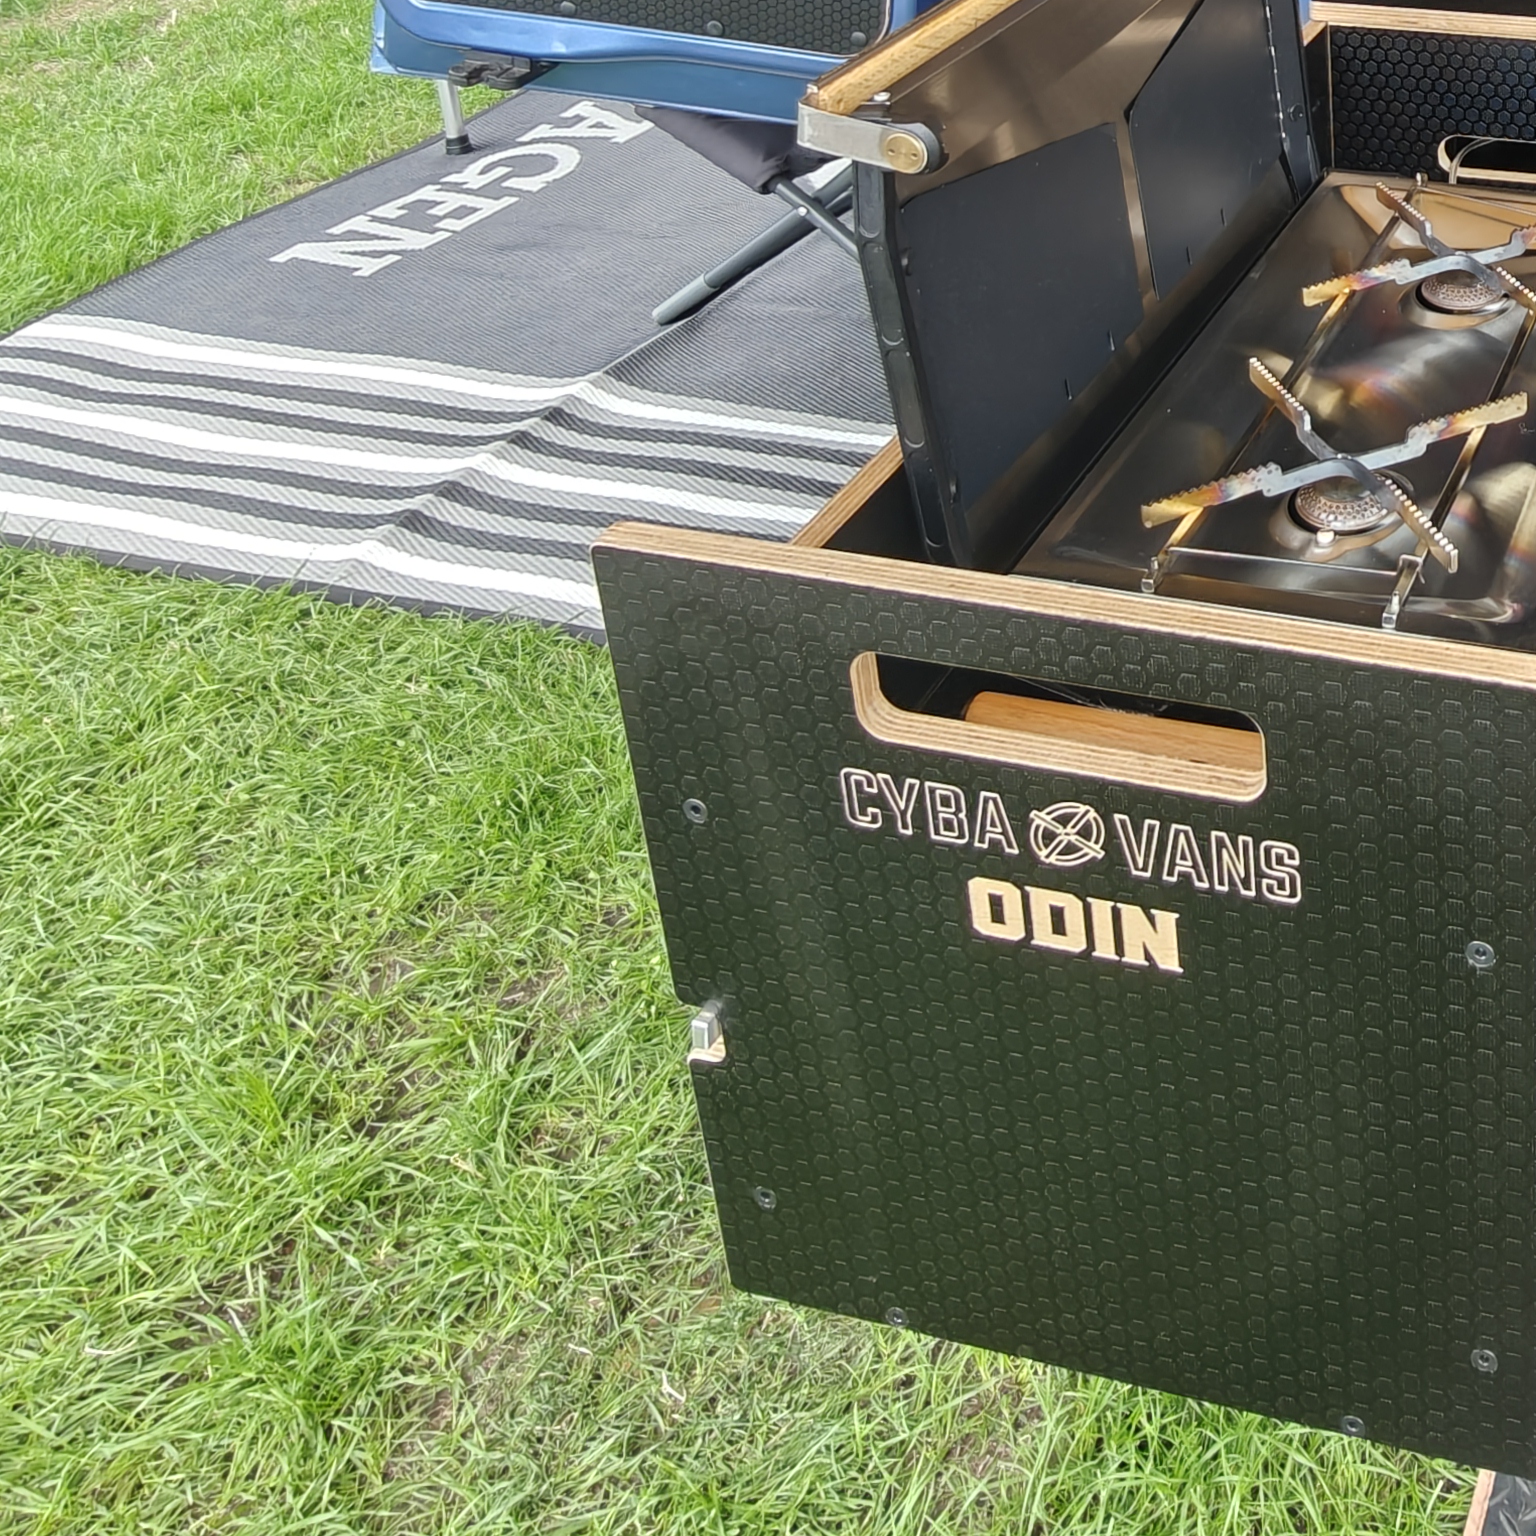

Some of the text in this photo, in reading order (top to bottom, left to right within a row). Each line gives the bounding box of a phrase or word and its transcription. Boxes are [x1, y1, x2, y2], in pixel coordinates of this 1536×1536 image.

[839, 766, 1302, 904] CYBA VANS
[966, 875, 1184, 974] ODIN
